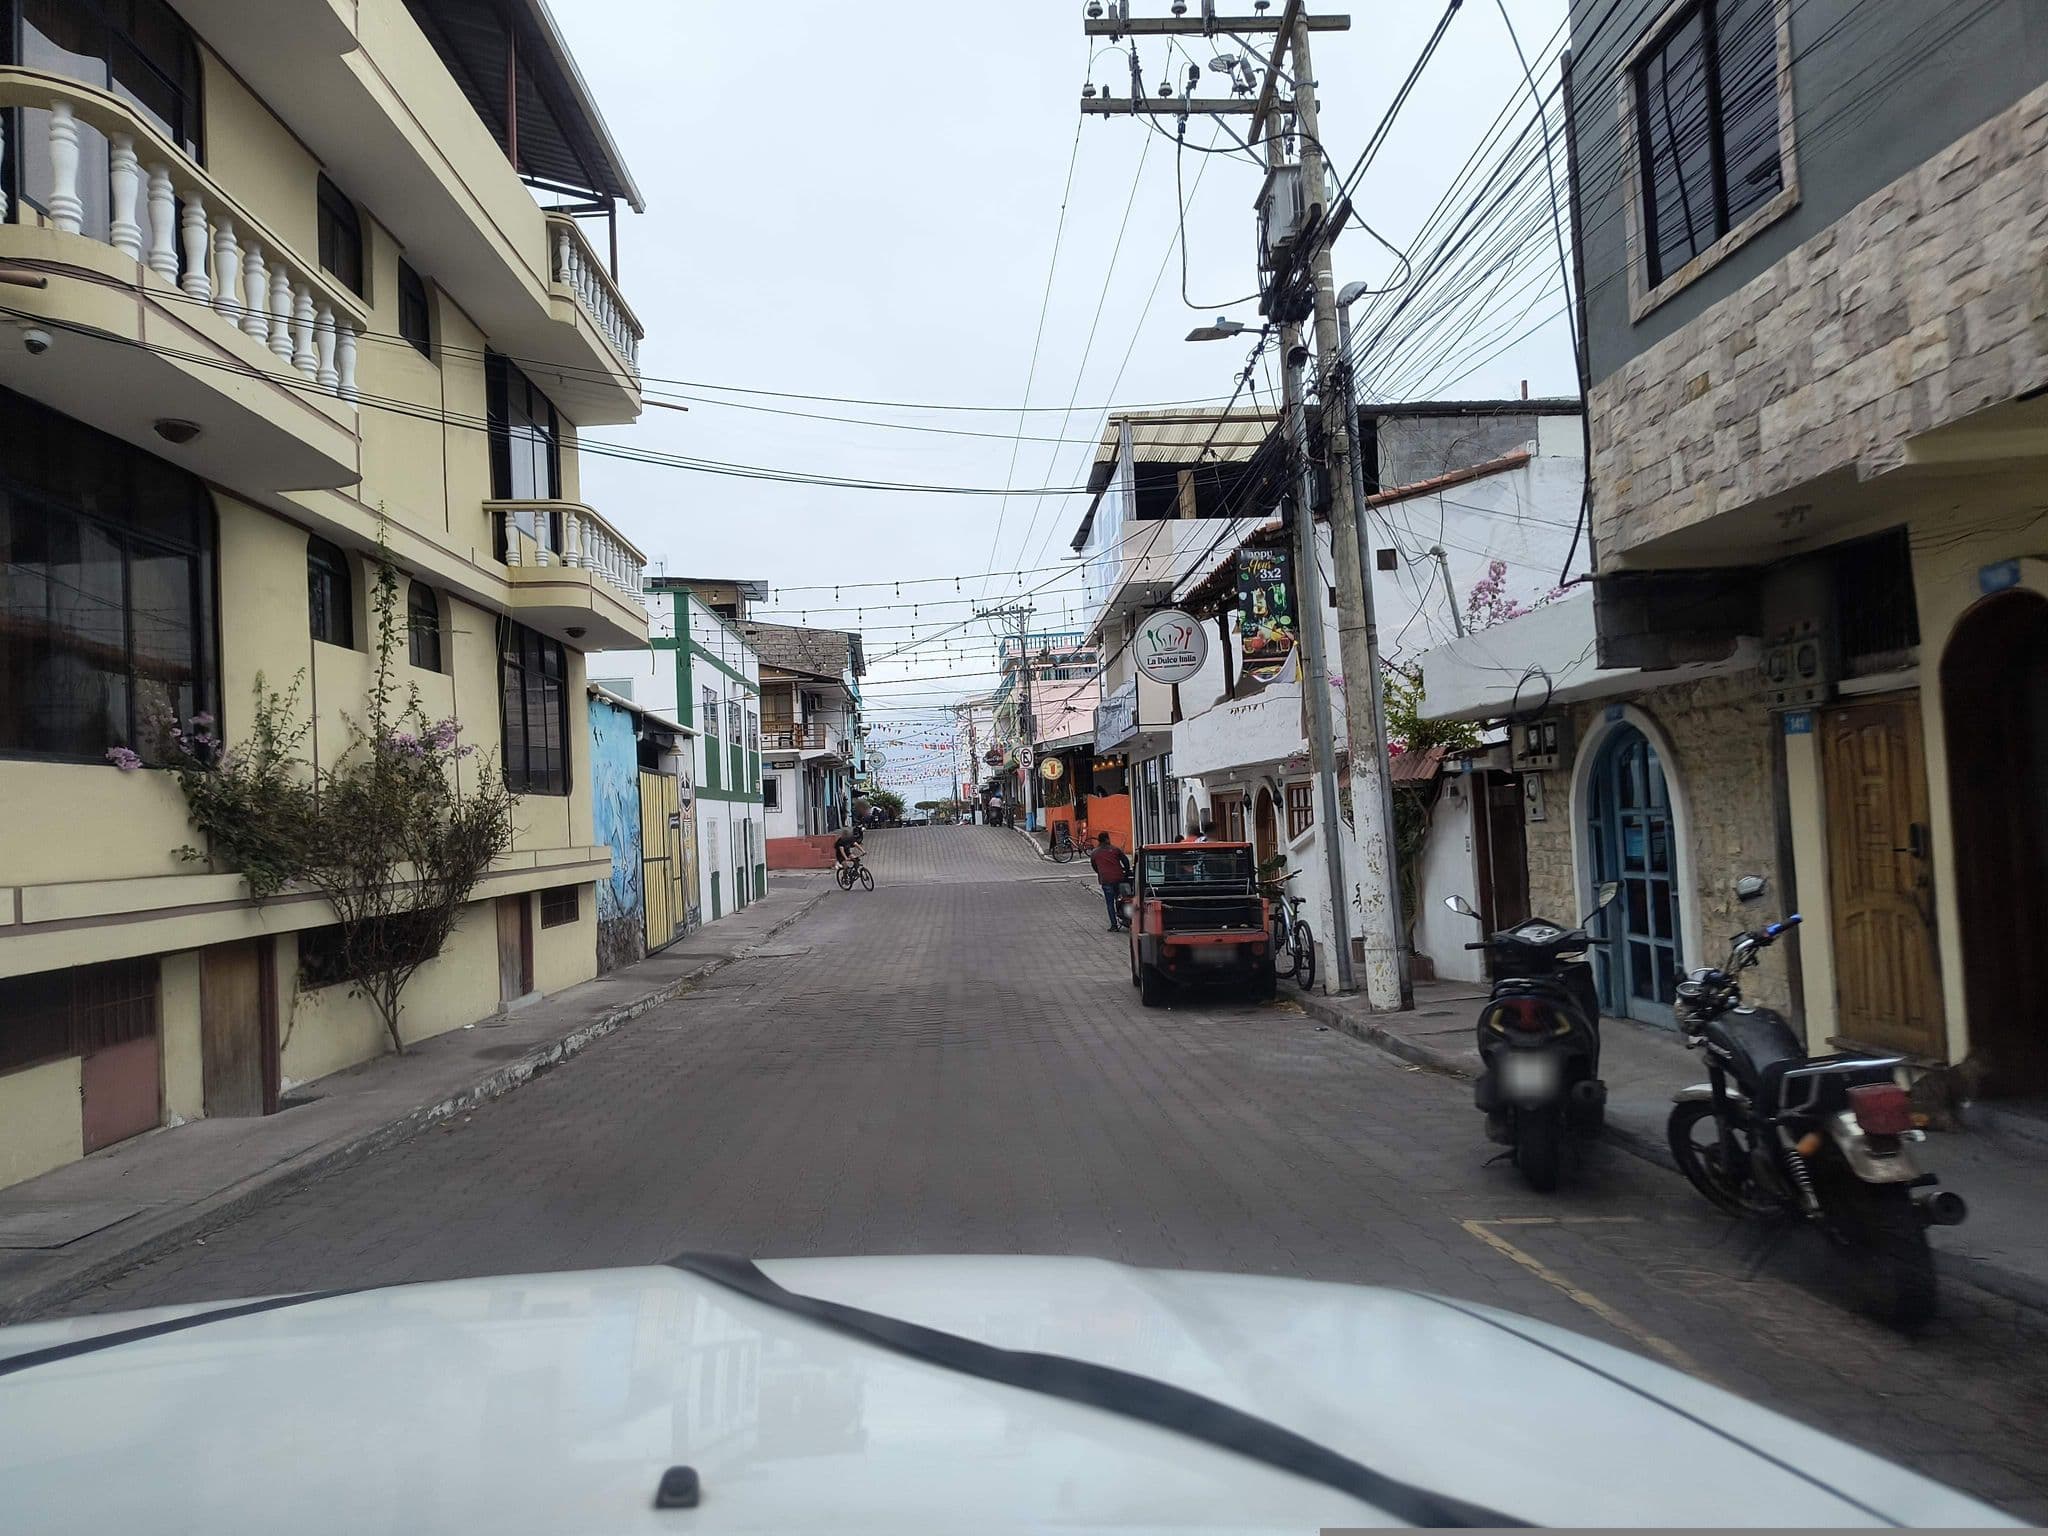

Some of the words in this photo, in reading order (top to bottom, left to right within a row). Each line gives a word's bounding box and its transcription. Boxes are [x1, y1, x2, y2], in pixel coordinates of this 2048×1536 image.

[1260, 567, 1282, 579] 3x2
[1147, 657, 1156, 666] La
[1157, 656, 1178, 665] Dulce
